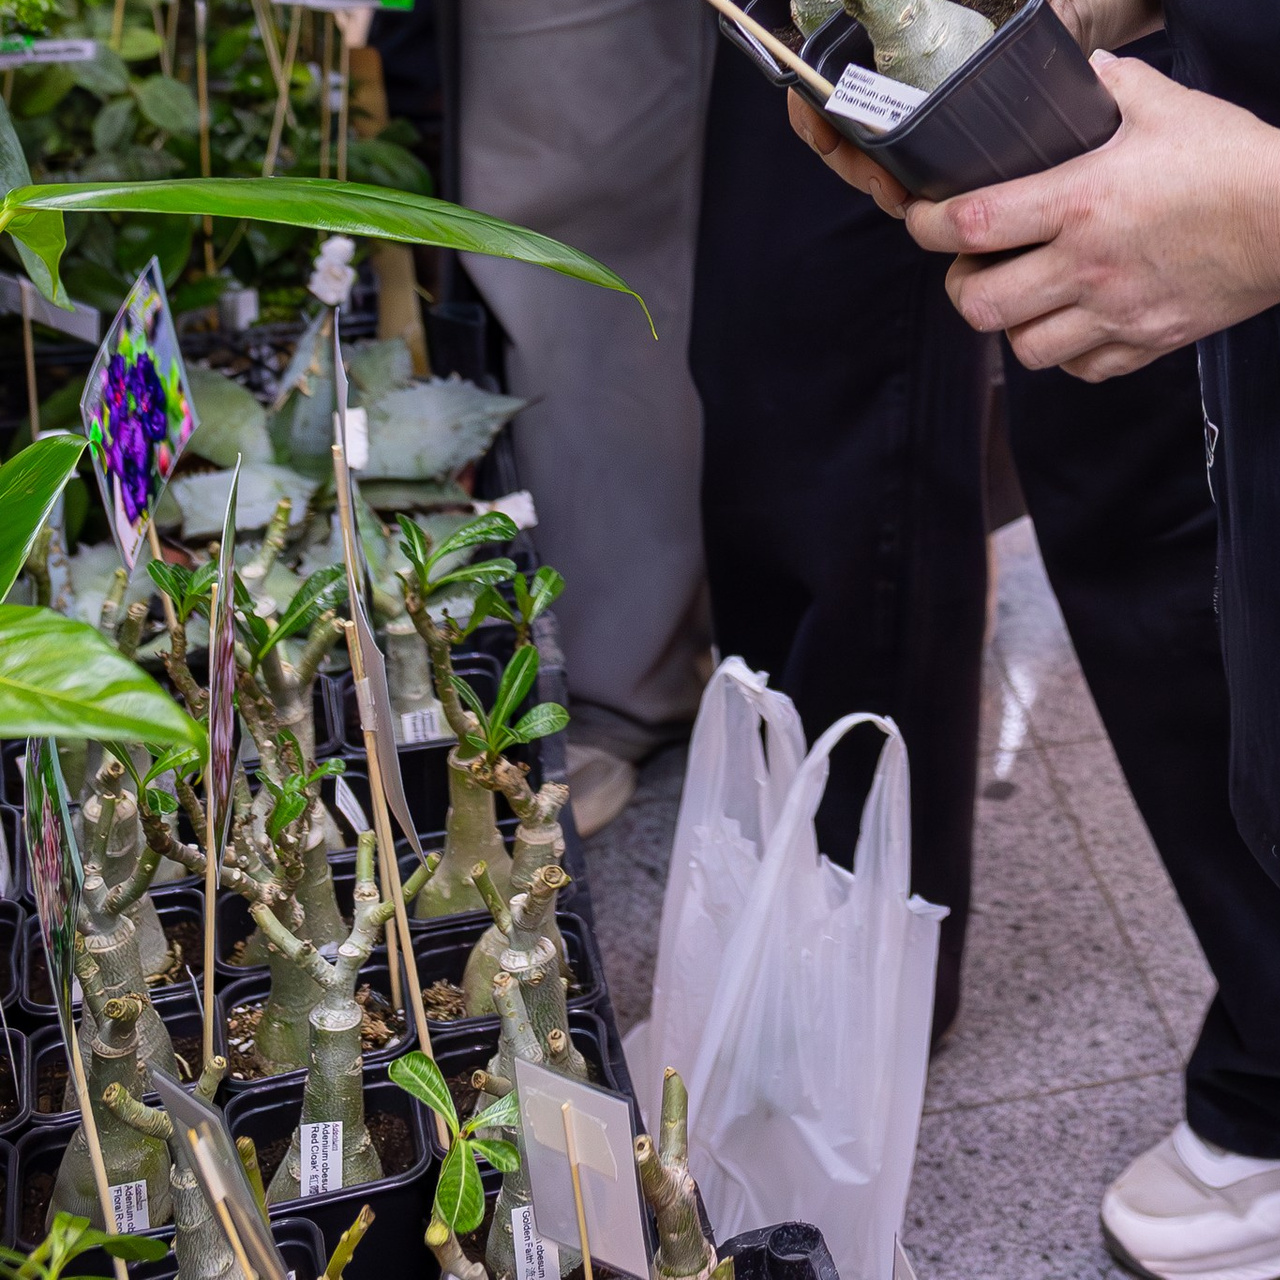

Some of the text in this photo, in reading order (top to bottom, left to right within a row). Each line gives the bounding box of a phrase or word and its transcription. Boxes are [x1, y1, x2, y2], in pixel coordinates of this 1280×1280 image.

[838, 77, 879, 101] Adenium
[322, 1123, 331, 1161] Adenium
[311, 1146, 320, 1171] Cloak'
[125, 1185, 135, 1222] Adenium
[525, 1243, 534, 1264] Faith'
[537, 1245, 545, 1278] obesum
